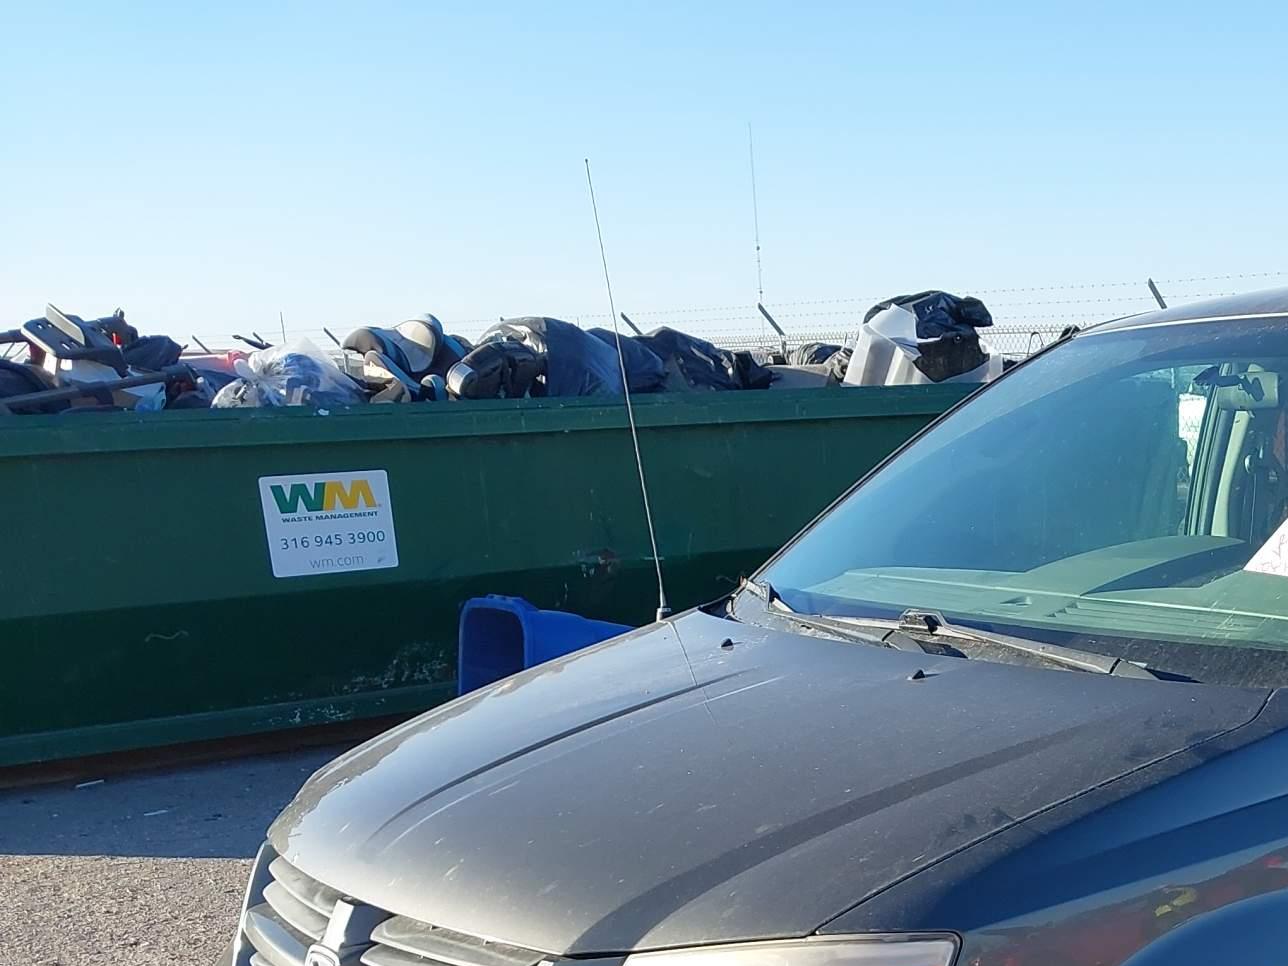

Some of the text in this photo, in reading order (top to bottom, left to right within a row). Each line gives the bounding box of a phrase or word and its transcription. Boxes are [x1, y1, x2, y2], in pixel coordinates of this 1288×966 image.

[270, 479, 377, 514] WM
[281, 511, 379, 524] WASTE MANAGEMENT
[280, 530, 386, 550] 316 945 3900
[309, 554, 364, 569] wm.com
